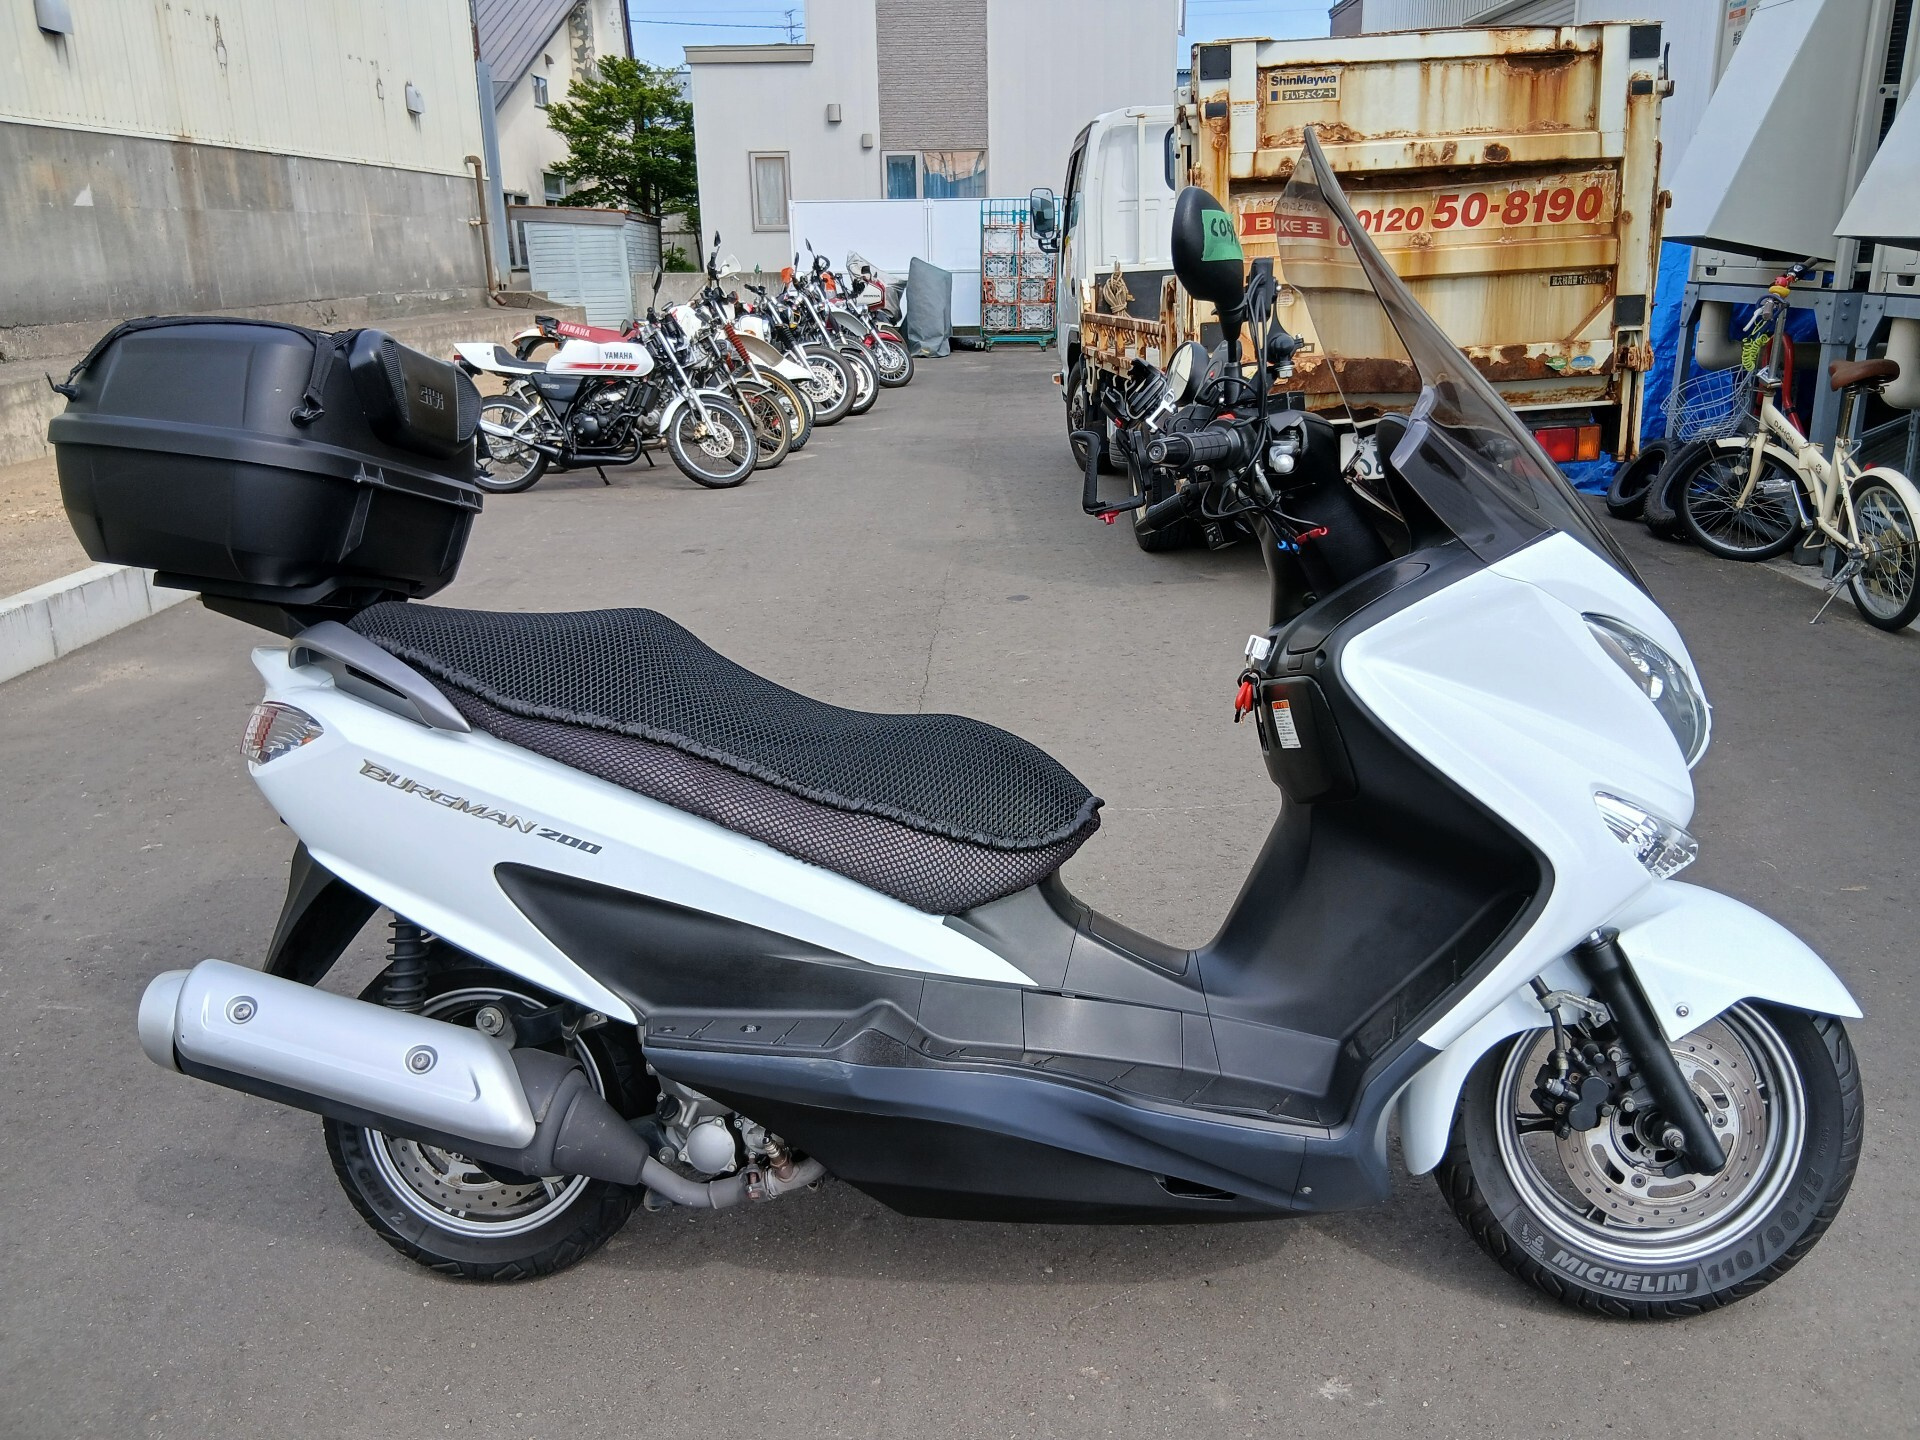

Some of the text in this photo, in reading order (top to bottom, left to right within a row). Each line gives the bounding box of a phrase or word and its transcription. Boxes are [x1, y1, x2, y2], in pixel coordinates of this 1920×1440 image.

[1270, 74, 1337, 87] ShinMaywa
[1283, 89, 1336, 100] すいちょくゲート
[1431, 185, 1604, 230] 50-8190
[559, 322, 591, 338] YAMAHA
[604, 351, 634, 360] YAMAHA
[1773, 420, 1795, 445] DAHON
[359, 758, 603, 855] BURGMAN 200
[357, 1167, 393, 1211] GRIP
[390, 1211, 407, 1225] 2
[1551, 1249, 1688, 1293] MICHELIN
